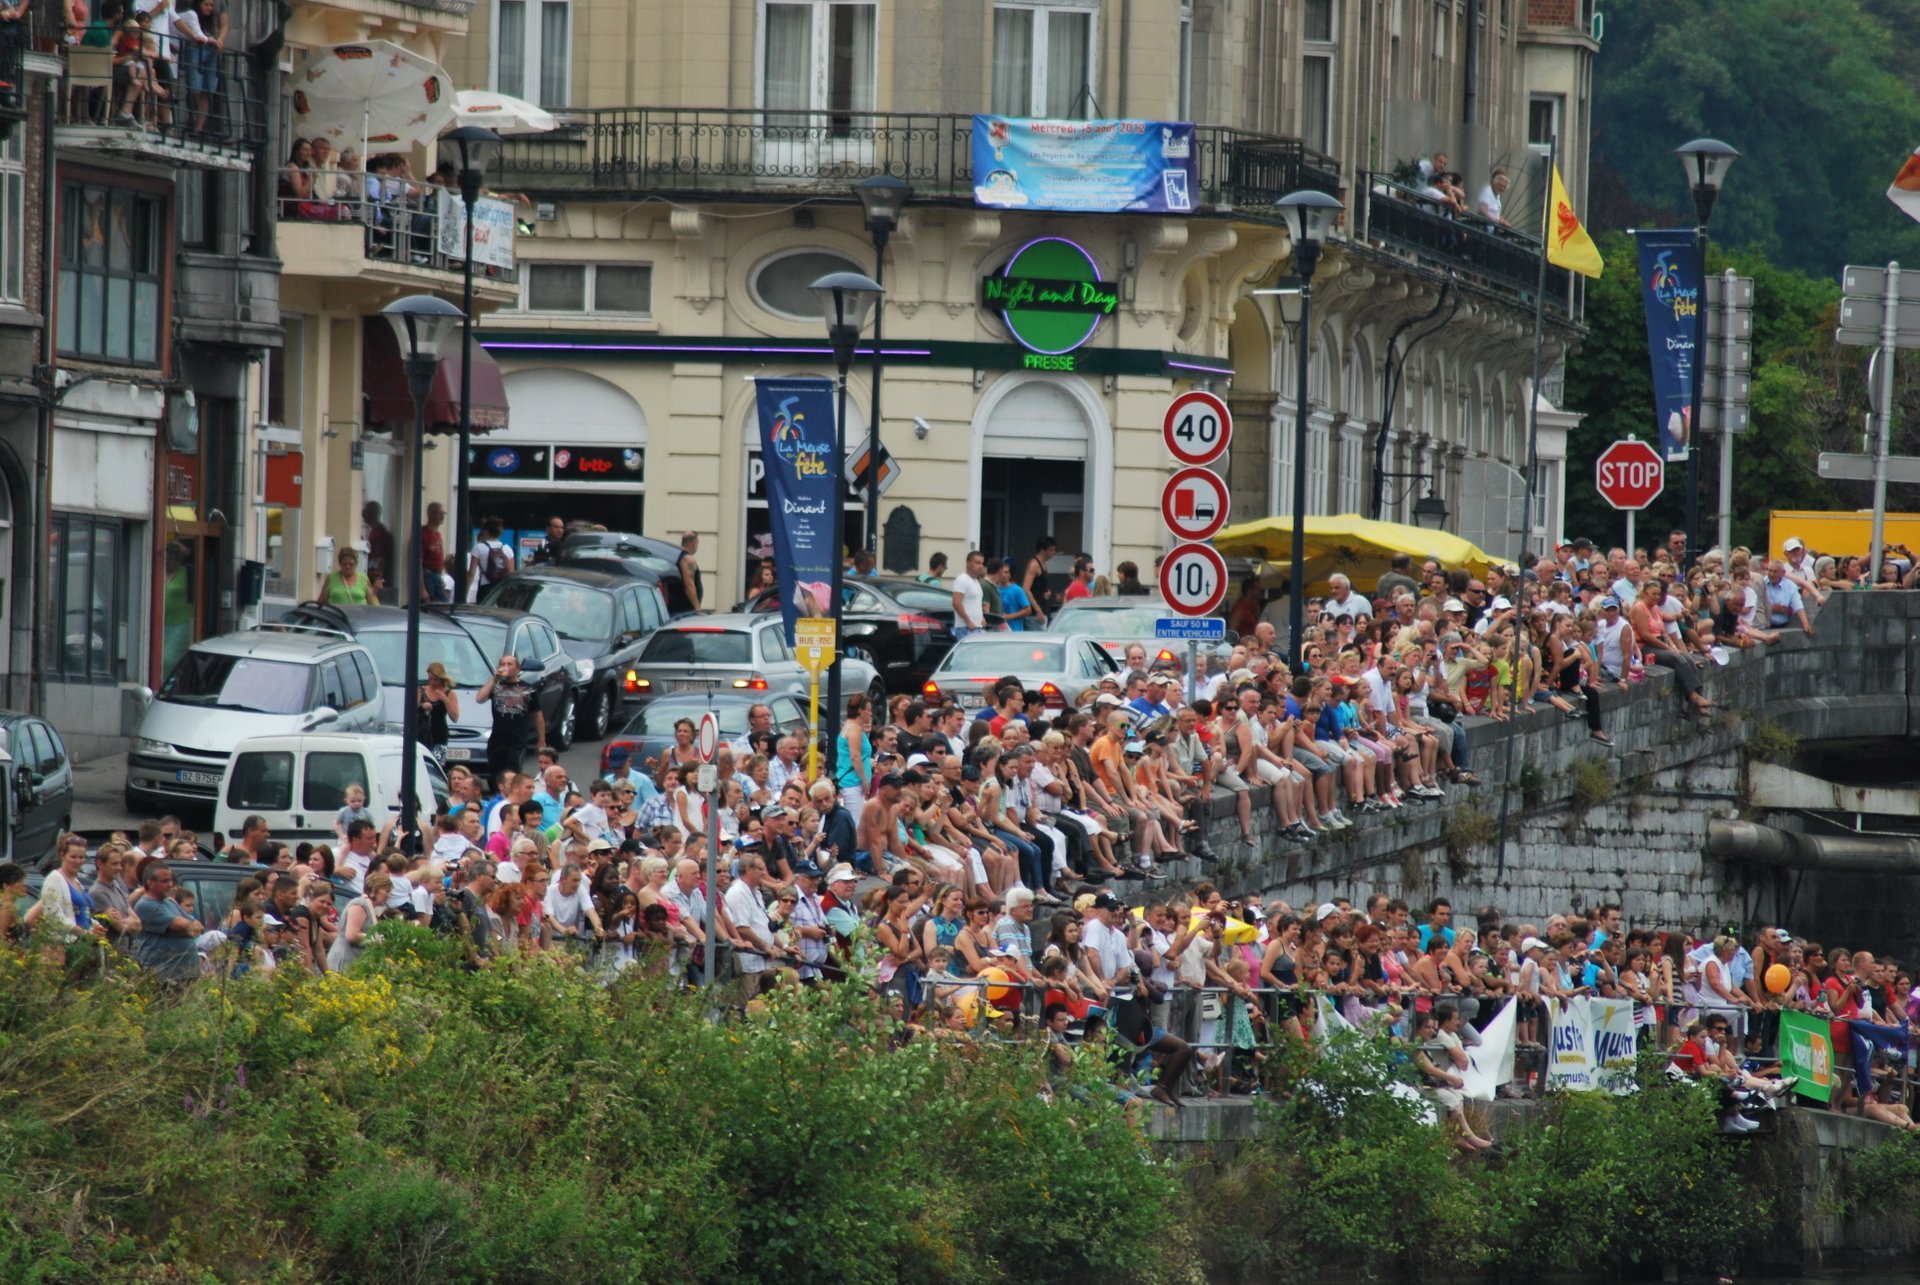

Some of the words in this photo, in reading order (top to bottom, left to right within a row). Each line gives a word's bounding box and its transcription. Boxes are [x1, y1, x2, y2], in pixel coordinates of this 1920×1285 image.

[1031, 123, 1077, 133] Mercredi
[986, 279, 1035, 309] Night
[1039, 283, 1076, 303] and
[1081, 281, 1118, 314] Day
[1673, 286, 1698, 299] Meus
[1665, 337, 1695, 350] Dinan
[1024, 354, 1075, 371] PRESSE
[1176, 414, 1217, 443] 40
[779, 442, 794, 452] La
[796, 440, 831, 455] Meuse
[795, 451, 828, 480] fête
[1601, 462, 1659, 489] STOP
[784, 498, 827, 514] Dinant
[1170, 620, 1190, 629] SAUF
[1190, 620, 1201, 629] 50
[1202, 620, 1209, 629] M
[799, 636, 814, 645] BUS
[1157, 629, 1182, 638] ENTRE
[1182, 629, 1222, 639] VEHICULES
